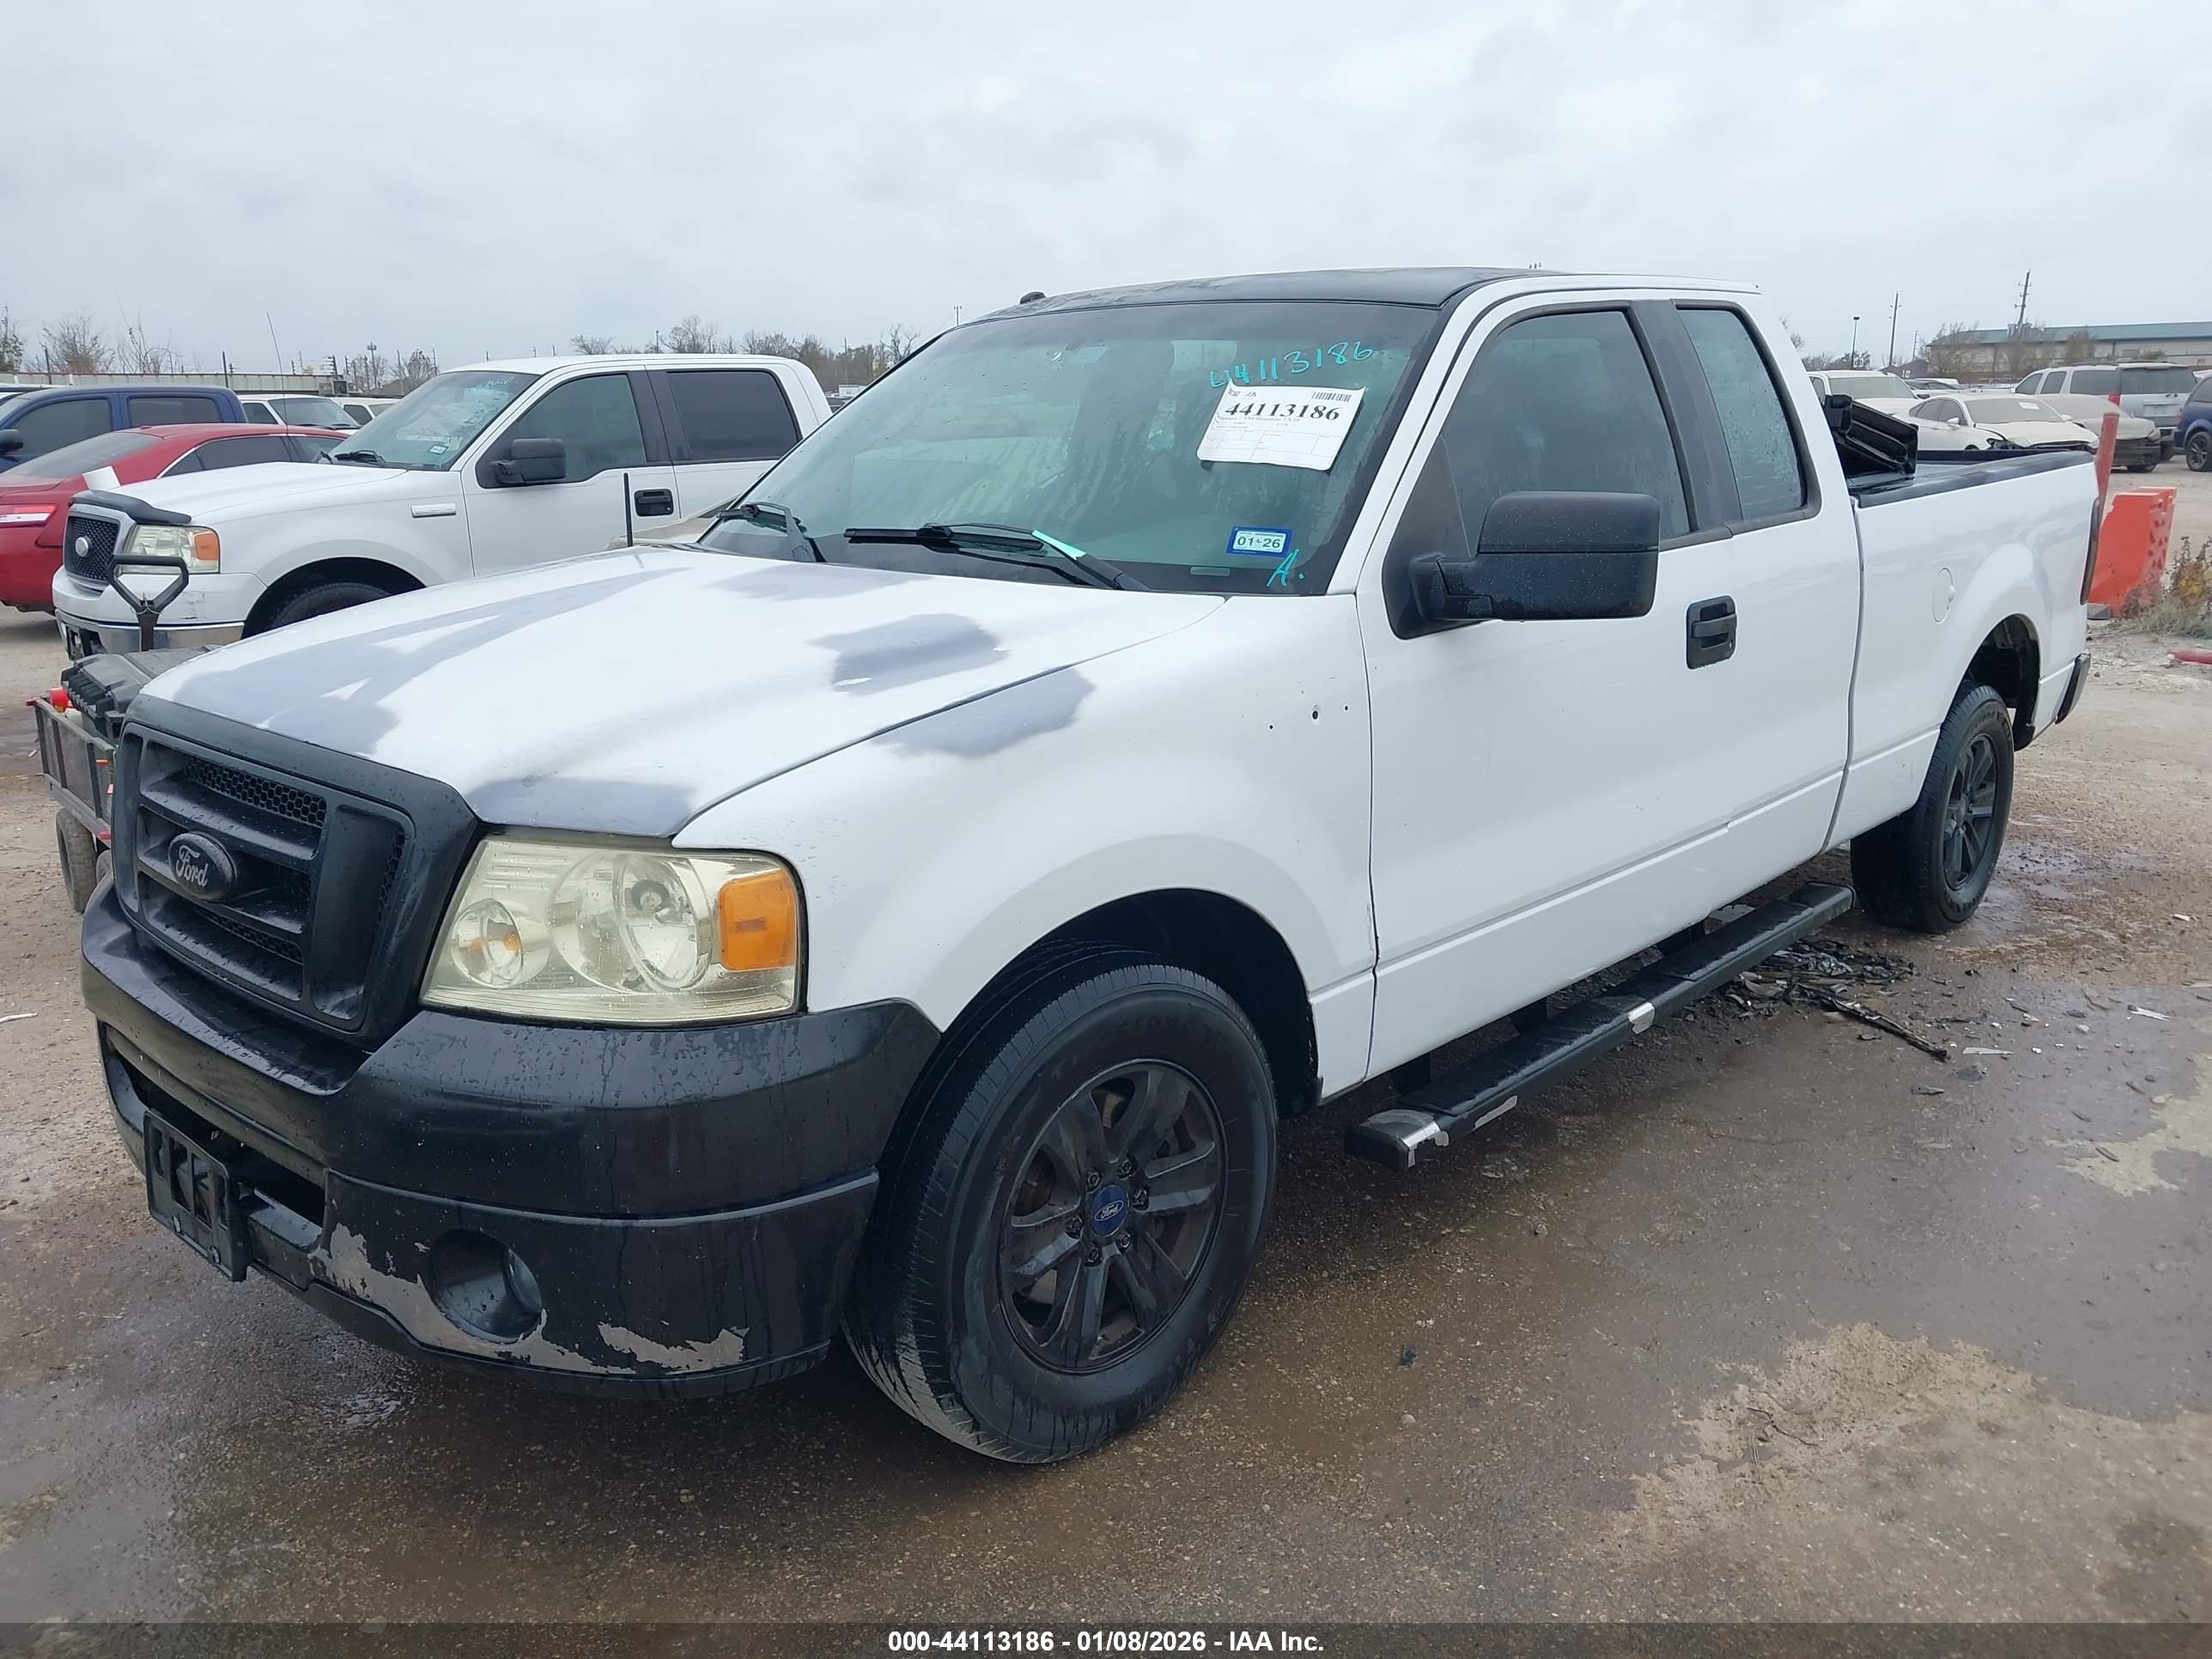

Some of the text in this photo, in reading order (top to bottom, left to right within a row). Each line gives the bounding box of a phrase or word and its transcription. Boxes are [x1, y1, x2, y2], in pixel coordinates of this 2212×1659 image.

[1224, 402, 1344, 422] 44113186
[175, 844, 209, 887] Ford
[1100, 1203, 1119, 1219] Ford
